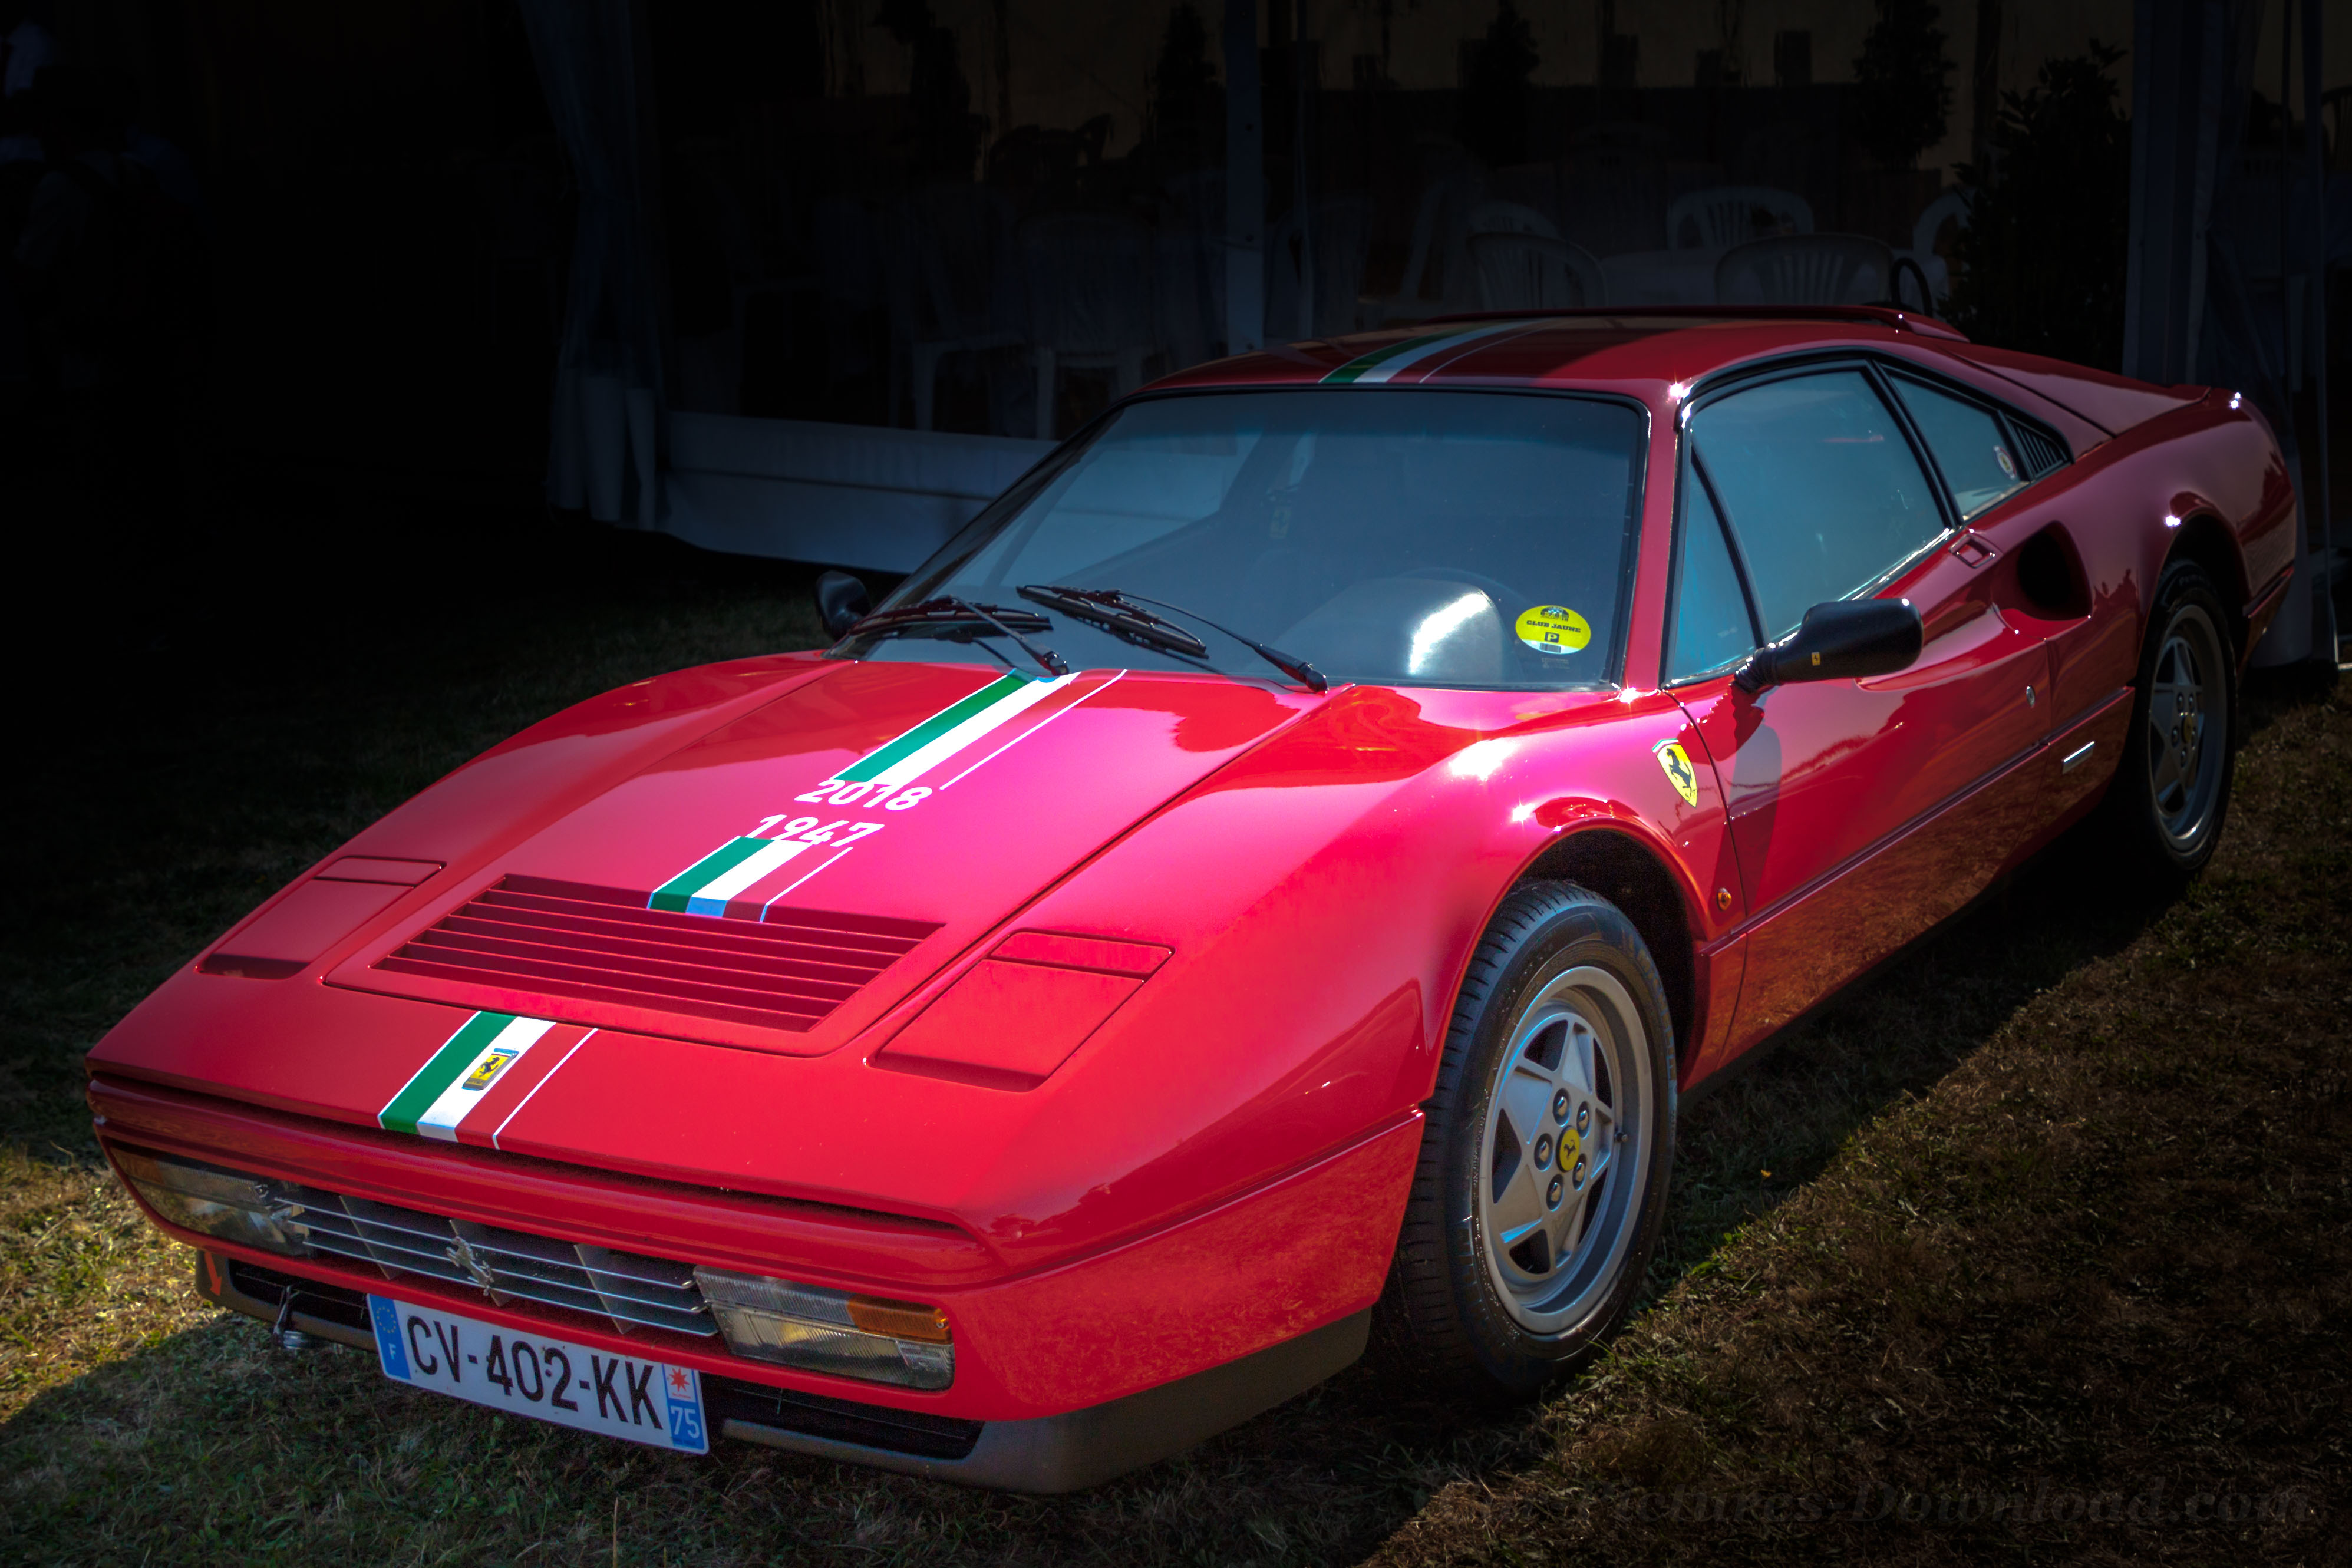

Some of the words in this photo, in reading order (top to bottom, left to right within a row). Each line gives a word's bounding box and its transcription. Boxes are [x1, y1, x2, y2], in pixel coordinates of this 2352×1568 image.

[1552, 623, 1581, 633] JAUNE
[794, 779, 933, 810] 2018
[745, 814, 885, 847] 1947
[388, 1344, 396, 1359] F
[407, 1315, 664, 1430] CV-402-KK
[670, 1405, 700, 1438] 75
